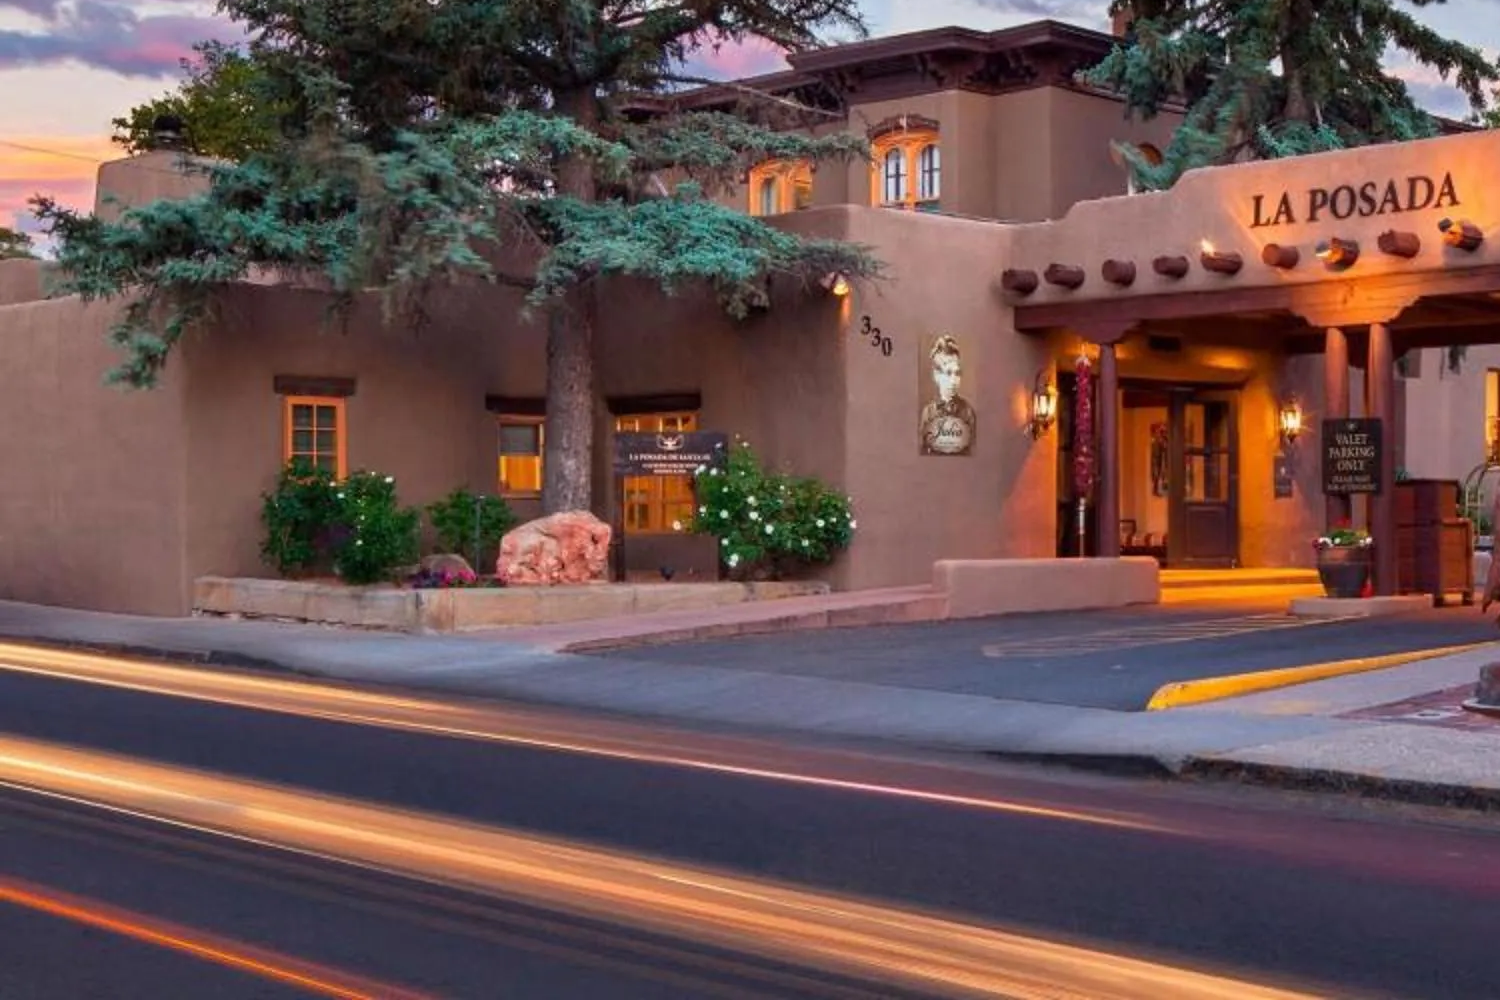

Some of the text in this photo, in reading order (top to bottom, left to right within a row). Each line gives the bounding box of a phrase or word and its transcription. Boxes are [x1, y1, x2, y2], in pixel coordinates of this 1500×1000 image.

[1250, 172, 1461, 228] LA POSADA
[861, 315, 893, 356] 330
[1336, 433, 1369, 445] VALET
[1328, 446, 1375, 459] PARKING
[1337, 459, 1365, 471] ONLY
